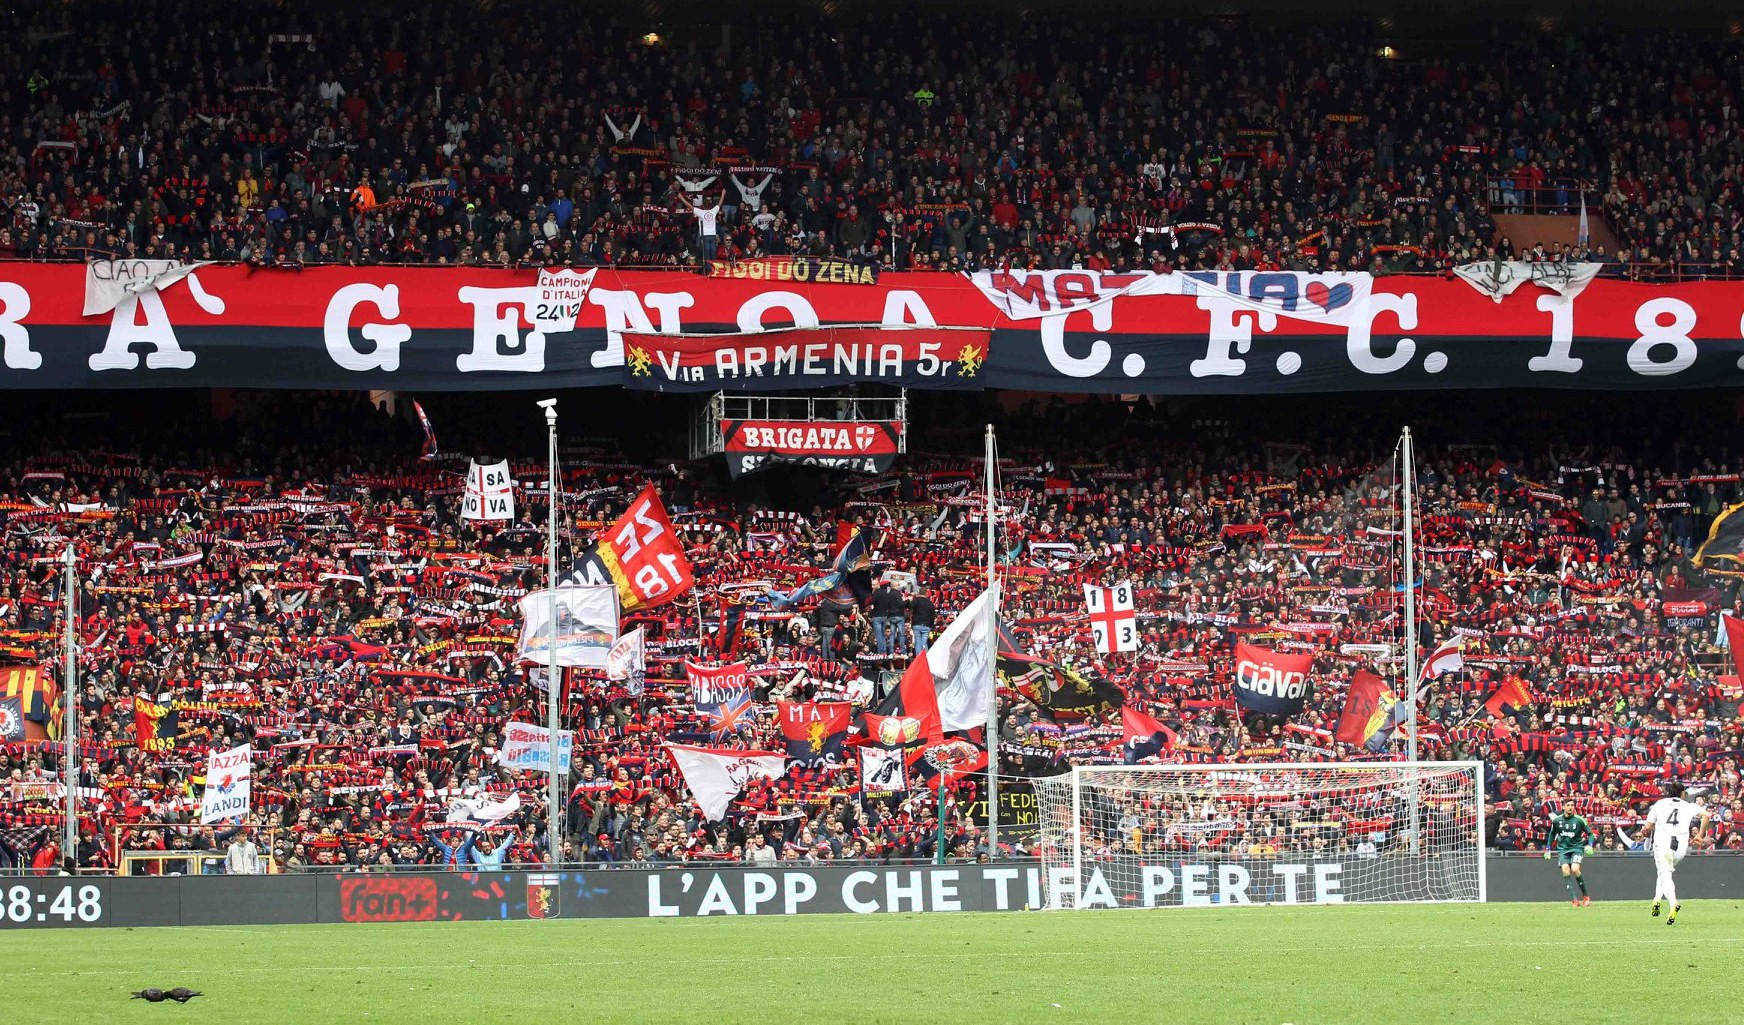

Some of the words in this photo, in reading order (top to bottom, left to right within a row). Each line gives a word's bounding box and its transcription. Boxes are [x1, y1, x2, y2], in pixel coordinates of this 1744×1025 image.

[815, 261, 876, 285] ZENA
[541, 277, 591, 288] CAMPIONI
[542, 289, 588, 300] D'ITALIA
[1528, 294, 1744, 377] 18
[714, 342, 903, 379] ARMENIA
[916, 341, 953, 378] 5r
[742, 426, 853, 451] BRIGATA
[486, 470, 505, 487] SA
[490, 496, 507, 513] VA
[1118, 587, 1127, 604] 8
[1123, 627, 1132, 644] 3
[1453, 627, 1485, 637] GENOA
[666, 638, 699, 649] BLOCK
[1588, 665, 1621, 674] BLOCK
[143, 737, 176, 751] 1893
[203, 796, 247, 816] LANDI
[1666, 809, 1679, 828] 4
[1560, 830, 1576, 838] Jeep
[647, 871, 817, 918] L'APP
[841, 869, 962, 914] CHE
[983, 866, 1119, 912] TIFA
[1141, 864, 1252, 907] PER
[1271, 862, 1345, 903] TE
